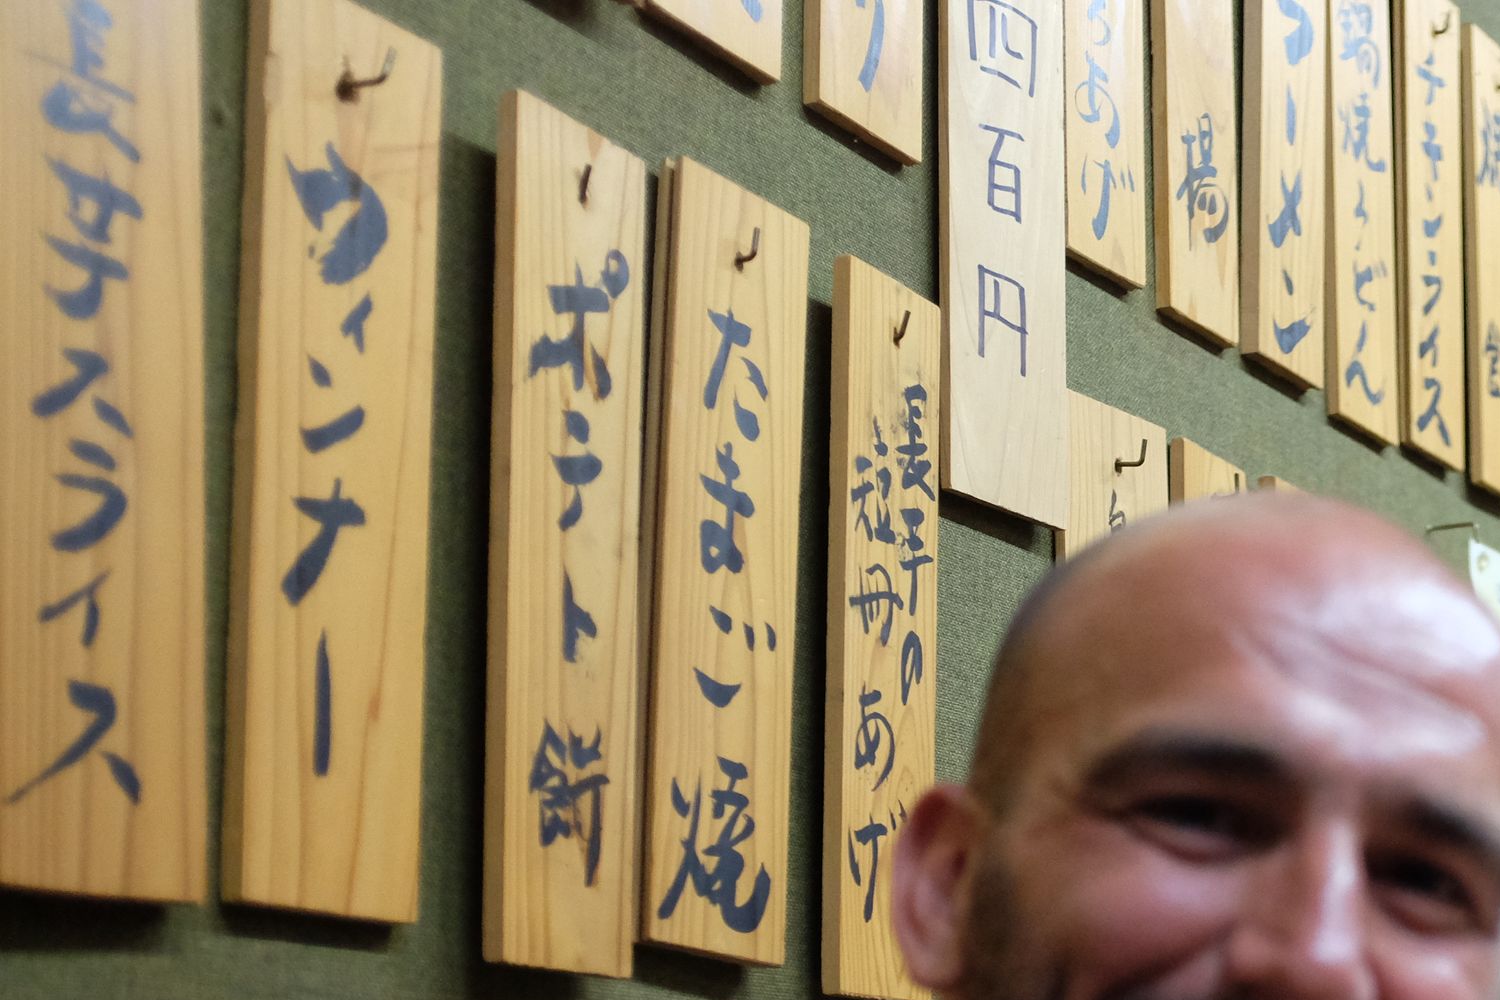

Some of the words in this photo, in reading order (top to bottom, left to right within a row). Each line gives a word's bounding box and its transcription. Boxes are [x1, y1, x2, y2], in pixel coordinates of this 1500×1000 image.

[966, 0, 1038, 378] 四百円
[658, 307, 777, 934] たまご焼
